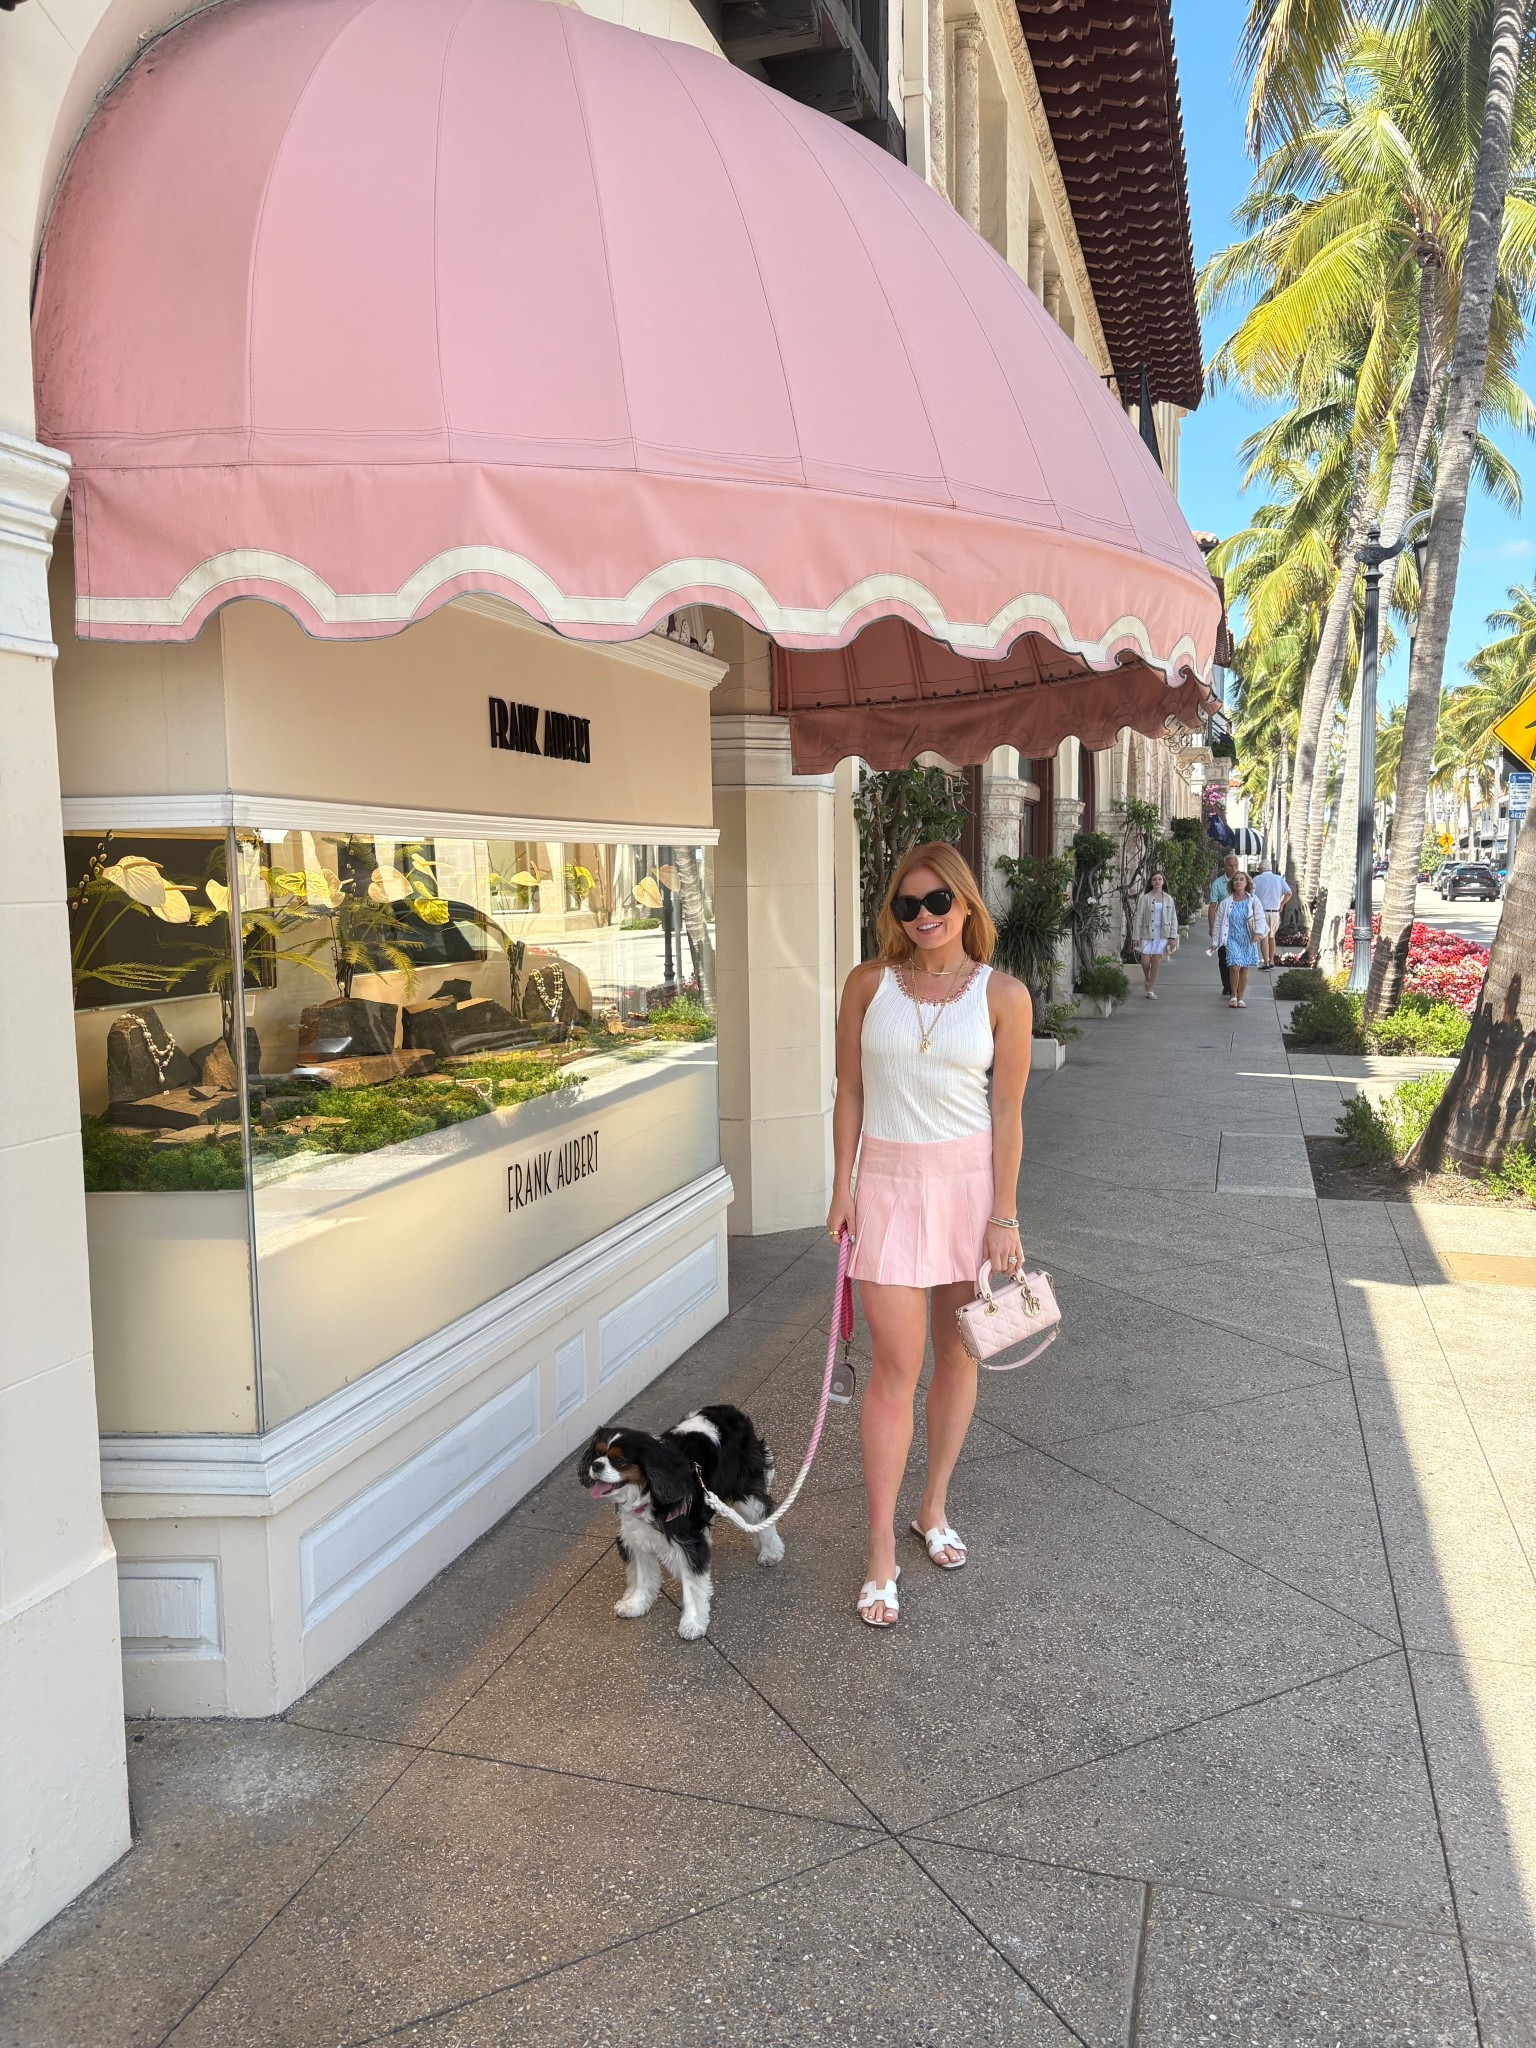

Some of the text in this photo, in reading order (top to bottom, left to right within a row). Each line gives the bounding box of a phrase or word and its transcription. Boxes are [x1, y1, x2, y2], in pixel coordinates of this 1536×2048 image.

[544, 710, 591, 763] AUBERT
[507, 1130, 599, 1213] FRANK AUBERT
